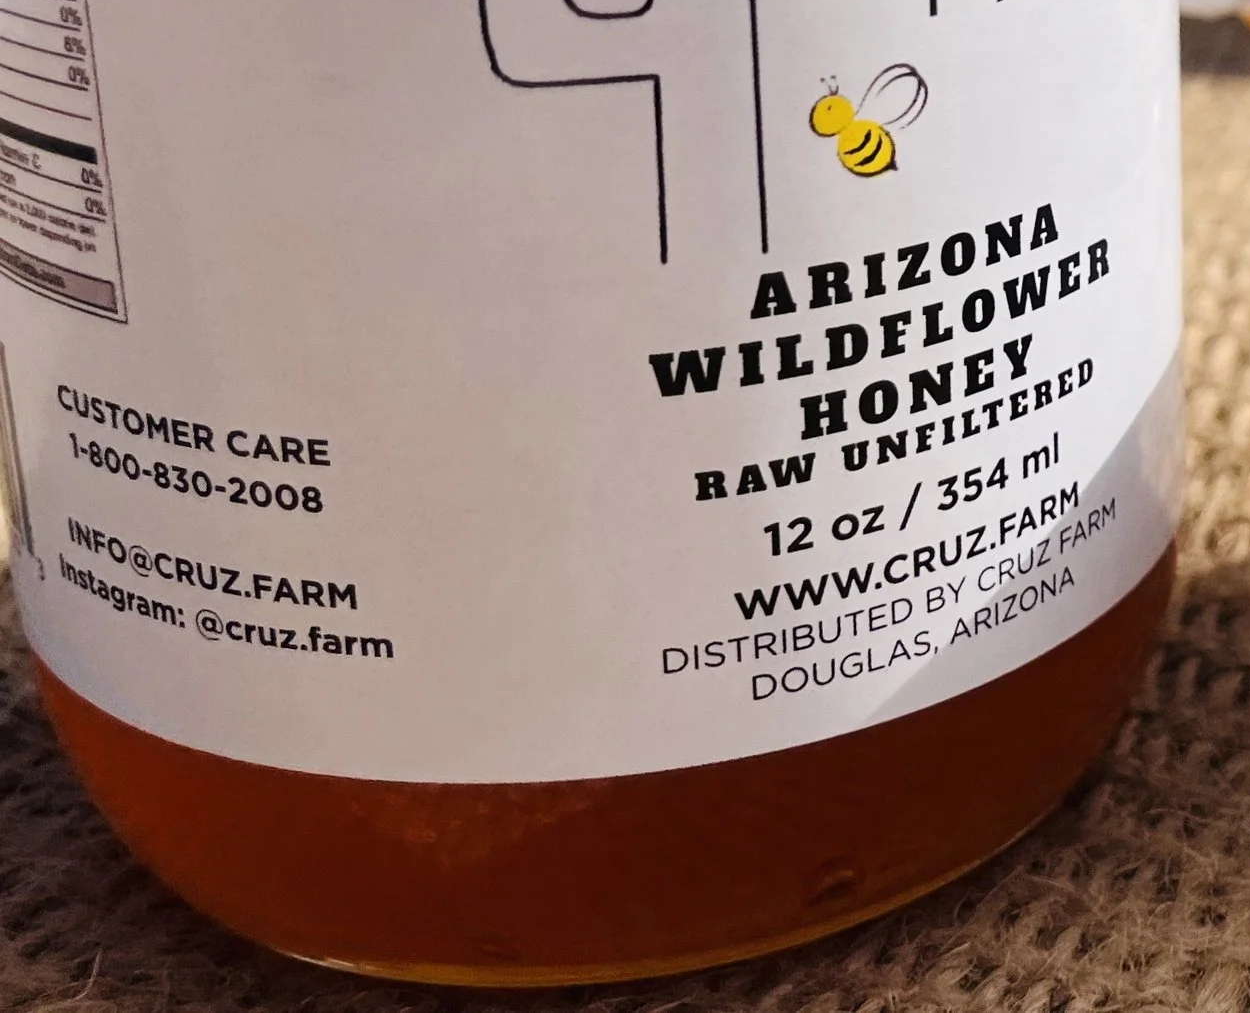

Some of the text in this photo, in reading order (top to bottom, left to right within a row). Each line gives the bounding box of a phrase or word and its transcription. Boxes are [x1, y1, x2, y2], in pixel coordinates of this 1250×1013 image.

[649, 238, 1109, 397] WILDFLOWER
[750, 203, 1058, 319] ARIZONA
[58, 385, 330, 466] CUSTOMER CARE
[695, 358, 1093, 501] RAW UNFILTERED
[800, 333, 1032, 440] HONEY
[69, 433, 323, 513] 1-800-830-2008
[764, 431, 1059, 556] 12 oz / 354 ml
[60, 553, 393, 658] Instagram: @cruz.farm
[68, 517, 357, 610] INFO@CRUZ.FARM
[663, 498, 1115, 674] DISTRIBUTED BY CRUZ FARM
[734, 481, 1078, 620] WWW.CRUZ.FARM
[752, 567, 1074, 700] DOUGLAS, ARIZONA
